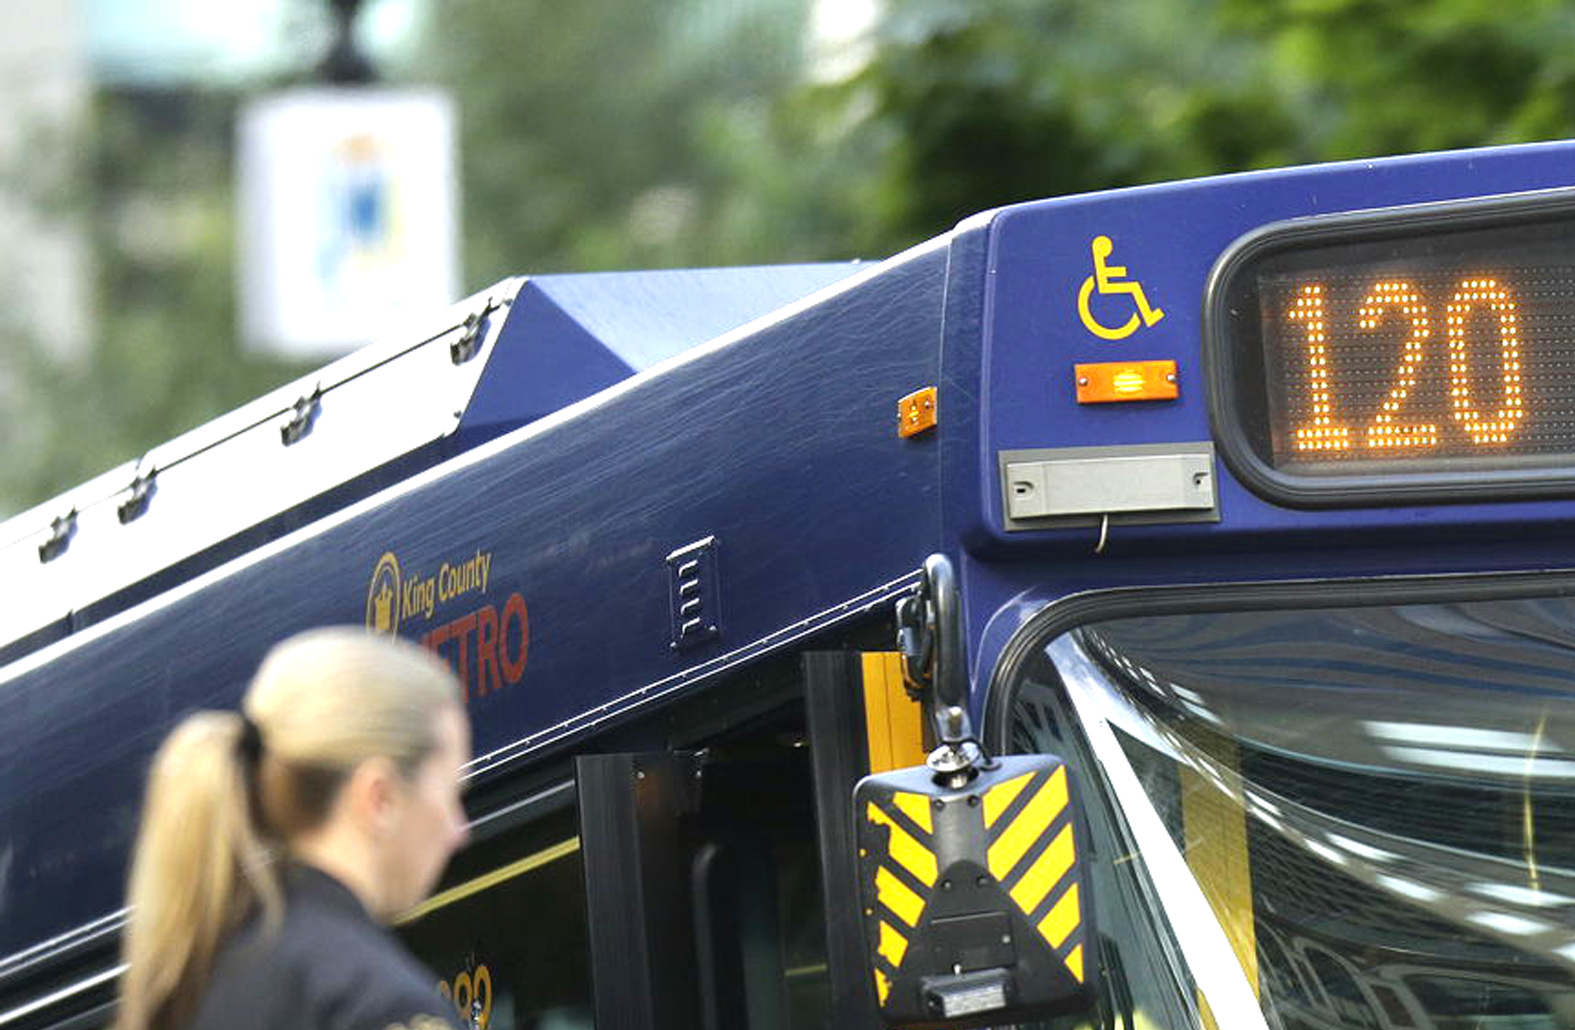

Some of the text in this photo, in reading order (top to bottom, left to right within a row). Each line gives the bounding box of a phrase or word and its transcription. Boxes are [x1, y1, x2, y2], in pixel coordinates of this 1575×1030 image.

[1288, 279, 1523, 450] 120
[402, 548, 492, 621] King County
[420, 592, 529, 704] TRO
